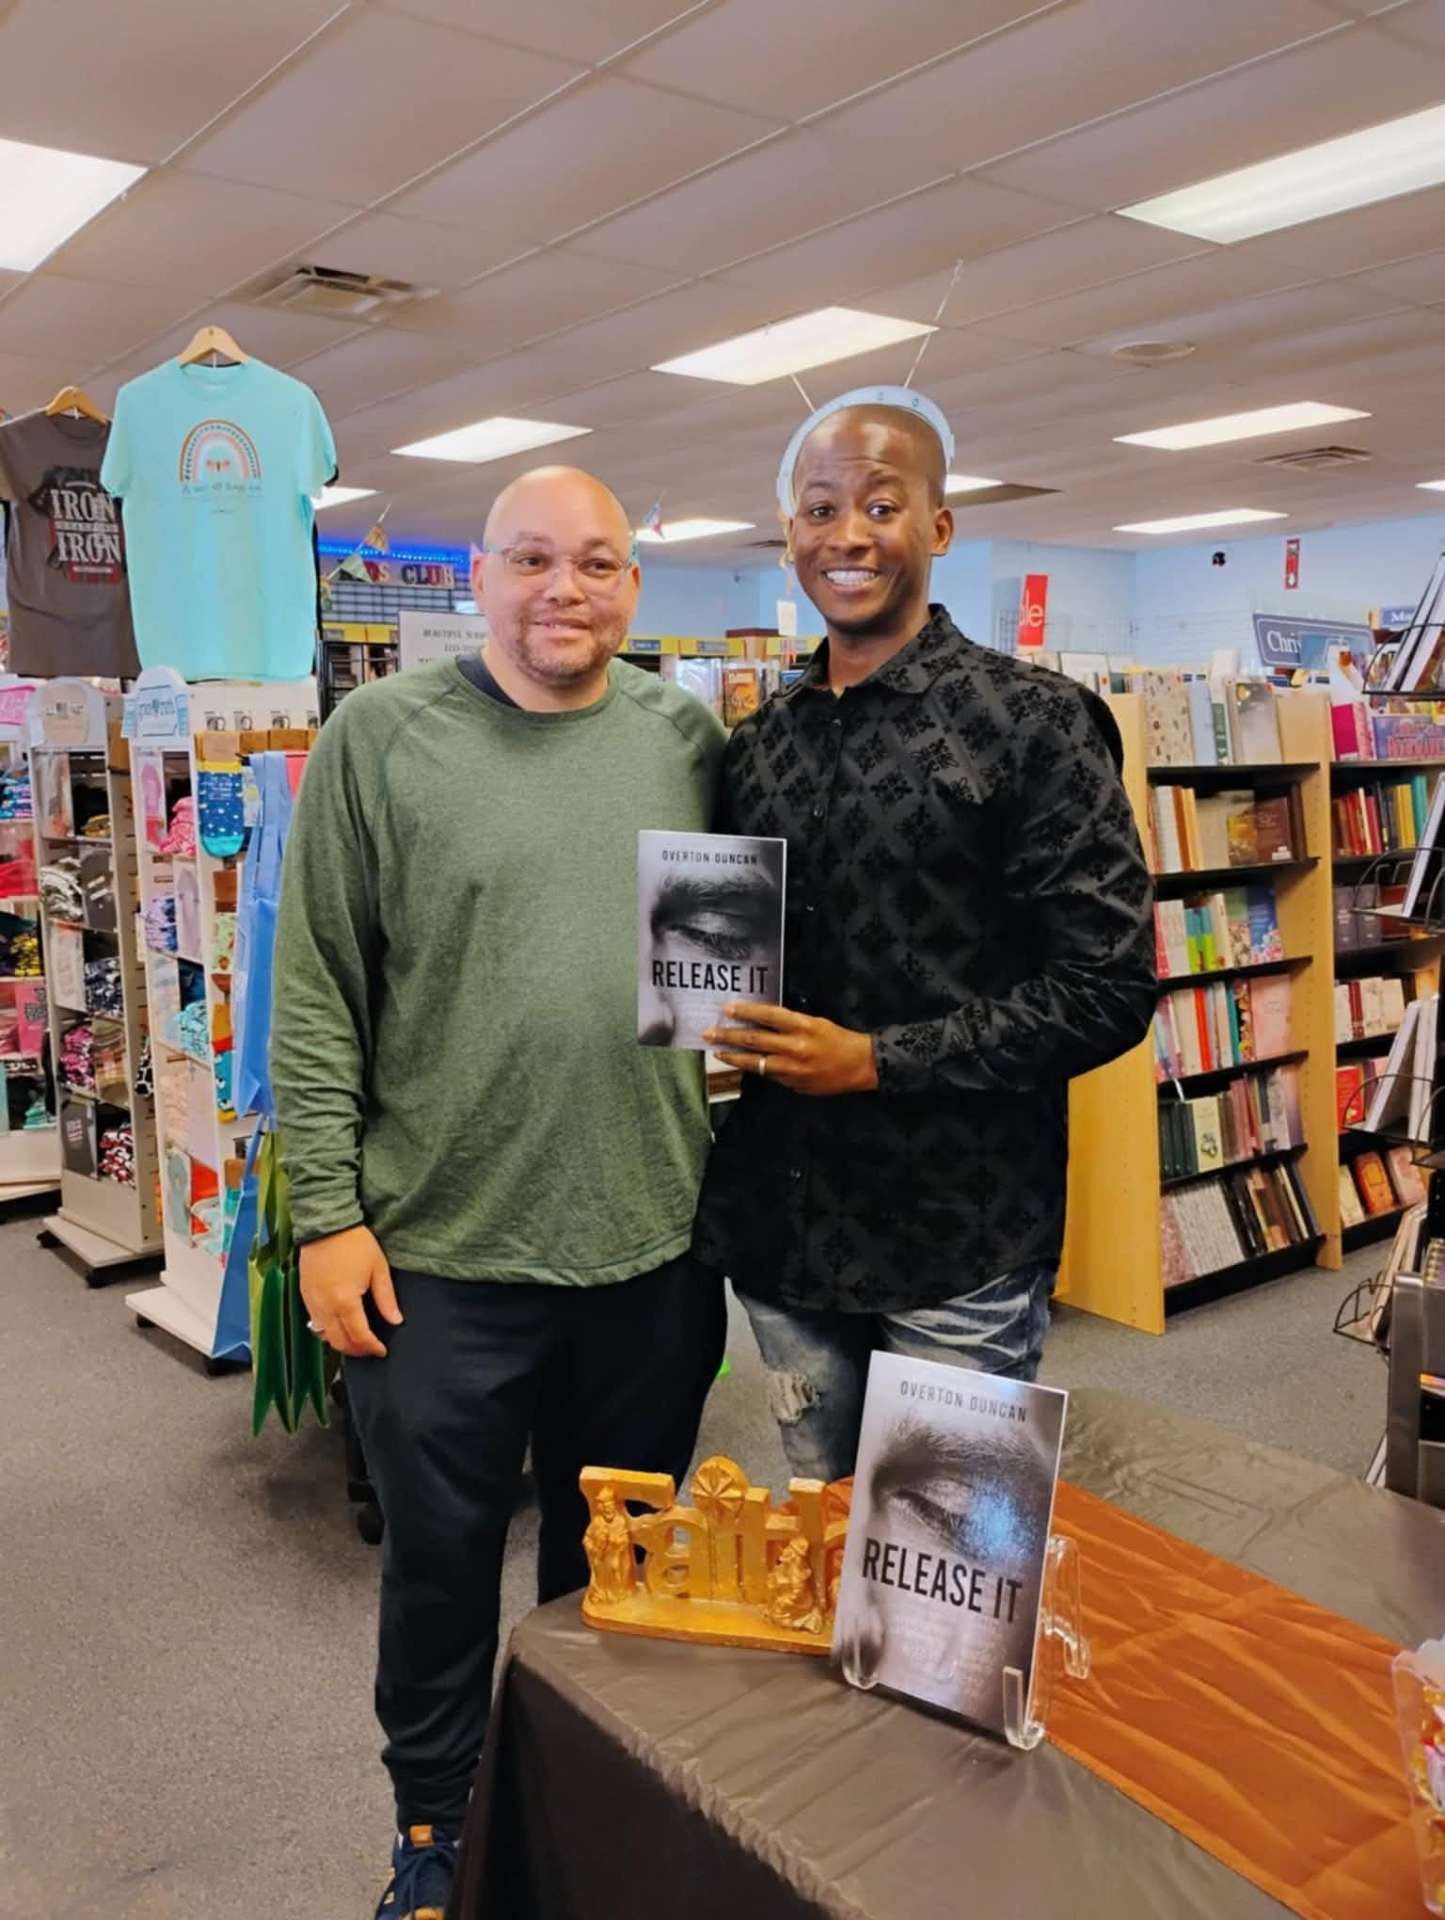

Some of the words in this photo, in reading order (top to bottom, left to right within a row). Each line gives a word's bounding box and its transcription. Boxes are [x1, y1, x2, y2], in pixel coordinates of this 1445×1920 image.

[50, 489, 116, 521] IRON
[57, 531, 121, 563] IRON
[402, 564, 455, 588] CLUB
[662, 850, 710, 864] OVERTON
[714, 854, 758, 865] DUNCAN
[652, 960, 742, 992] RELEASE
[750, 966, 769, 994] IT
[900, 1380, 964, 1408] OVERTON
[969, 1396, 1027, 1423] DUNCAN
[862, 1537, 986, 1613] RELEASE
[992, 1575, 1024, 1623] IT
